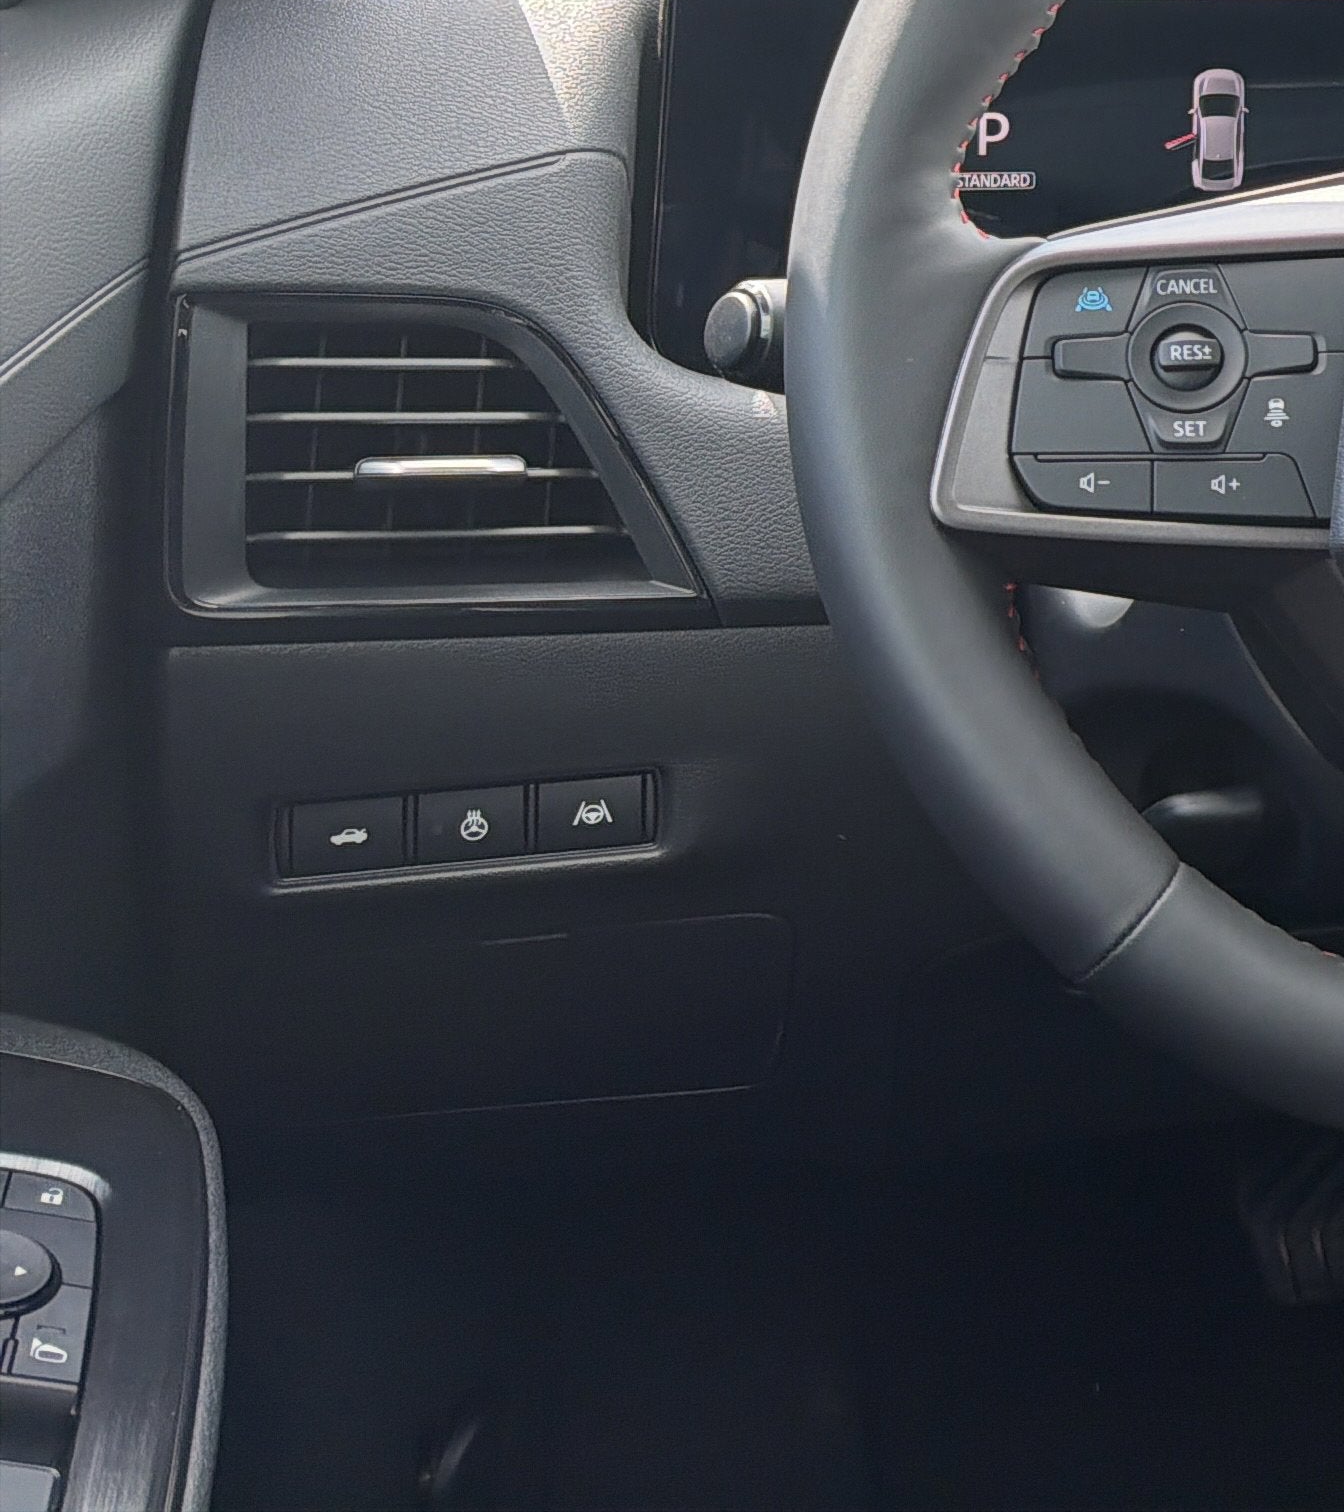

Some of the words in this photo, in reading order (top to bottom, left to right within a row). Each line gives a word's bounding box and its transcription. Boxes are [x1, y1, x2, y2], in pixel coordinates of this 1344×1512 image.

[977, 111, 1011, 157] P
[1156, 278, 1218, 296] CANCEL
[1172, 420, 1207, 438] SET
